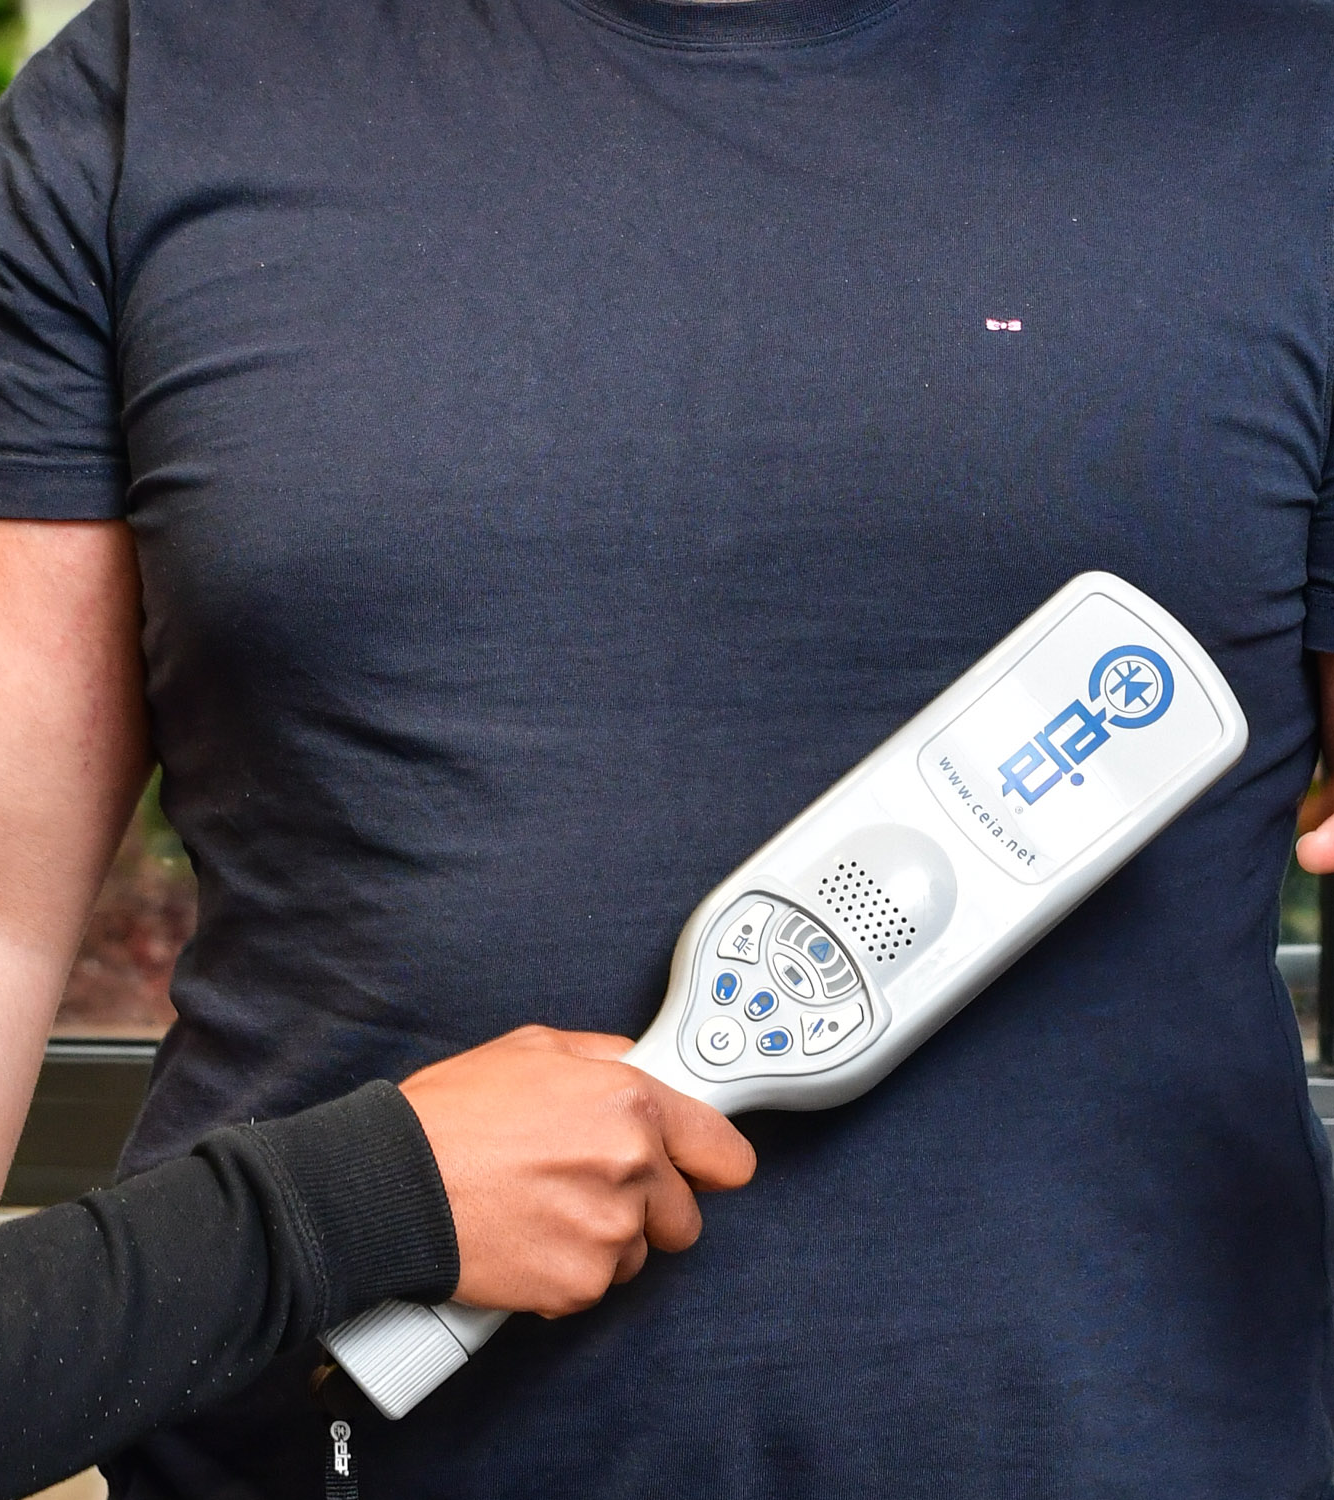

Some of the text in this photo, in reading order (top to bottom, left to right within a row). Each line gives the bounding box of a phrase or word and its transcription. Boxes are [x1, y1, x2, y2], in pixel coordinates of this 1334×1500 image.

[938, 755, 1037, 867] www.ceia.net
[749, 1001, 763, 1016] M
[761, 1037, 772, 1048] H
